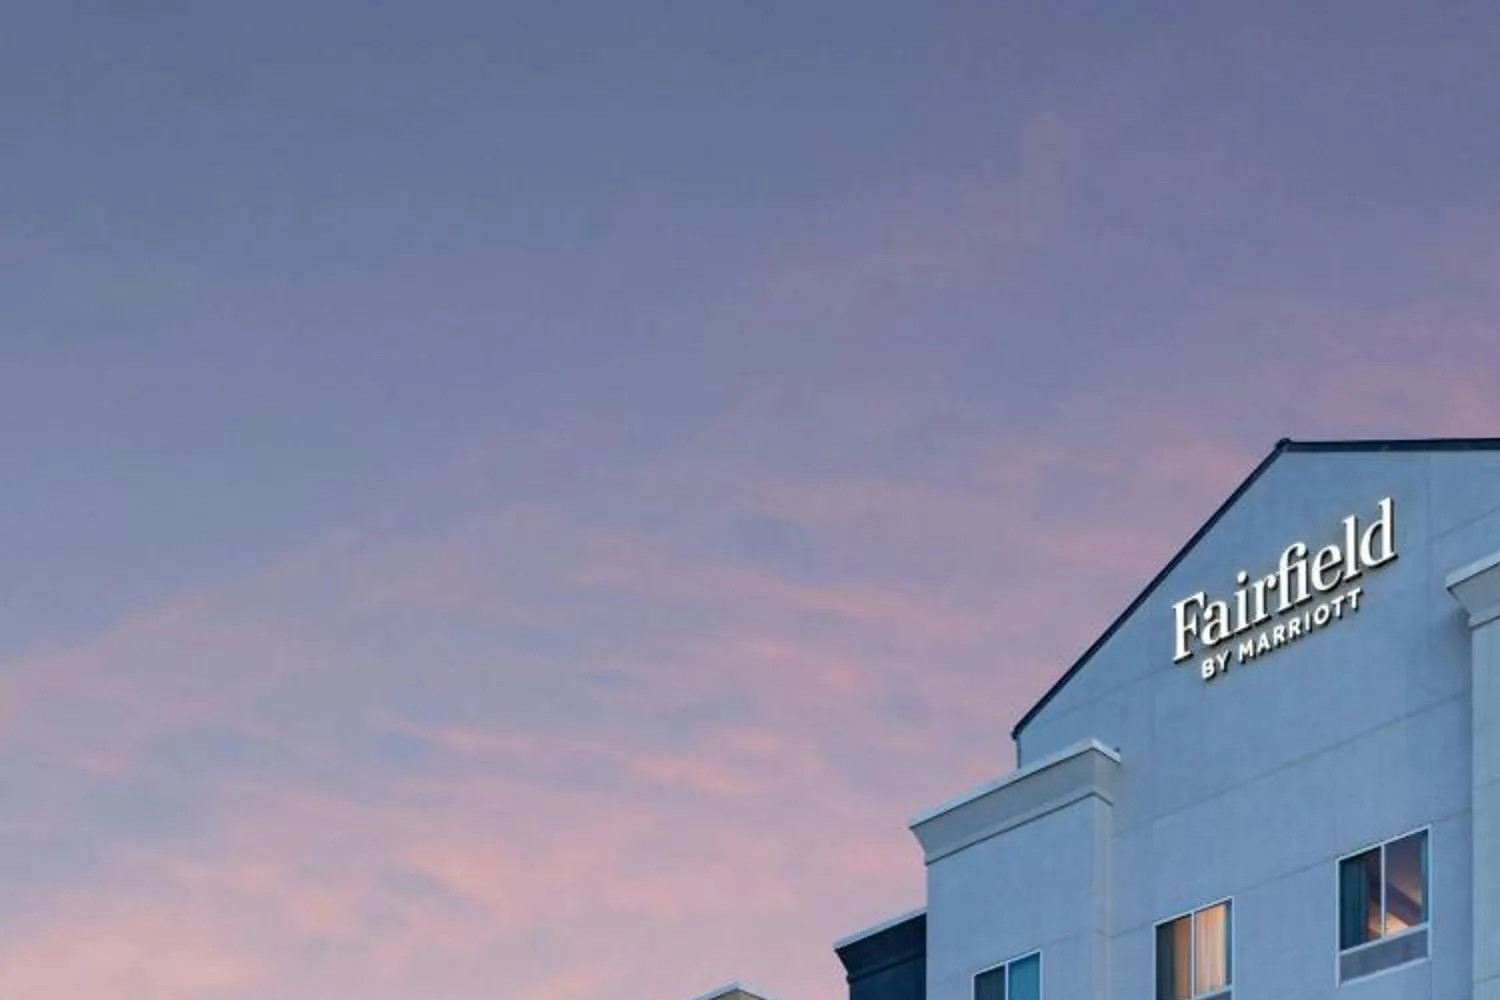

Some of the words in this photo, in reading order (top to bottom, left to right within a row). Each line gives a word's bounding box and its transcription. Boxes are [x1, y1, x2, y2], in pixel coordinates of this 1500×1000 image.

[1172, 497, 1397, 662] Fairfield
[1202, 650, 1231, 680] BY
[1239, 586, 1362, 663] MARRIOTT
